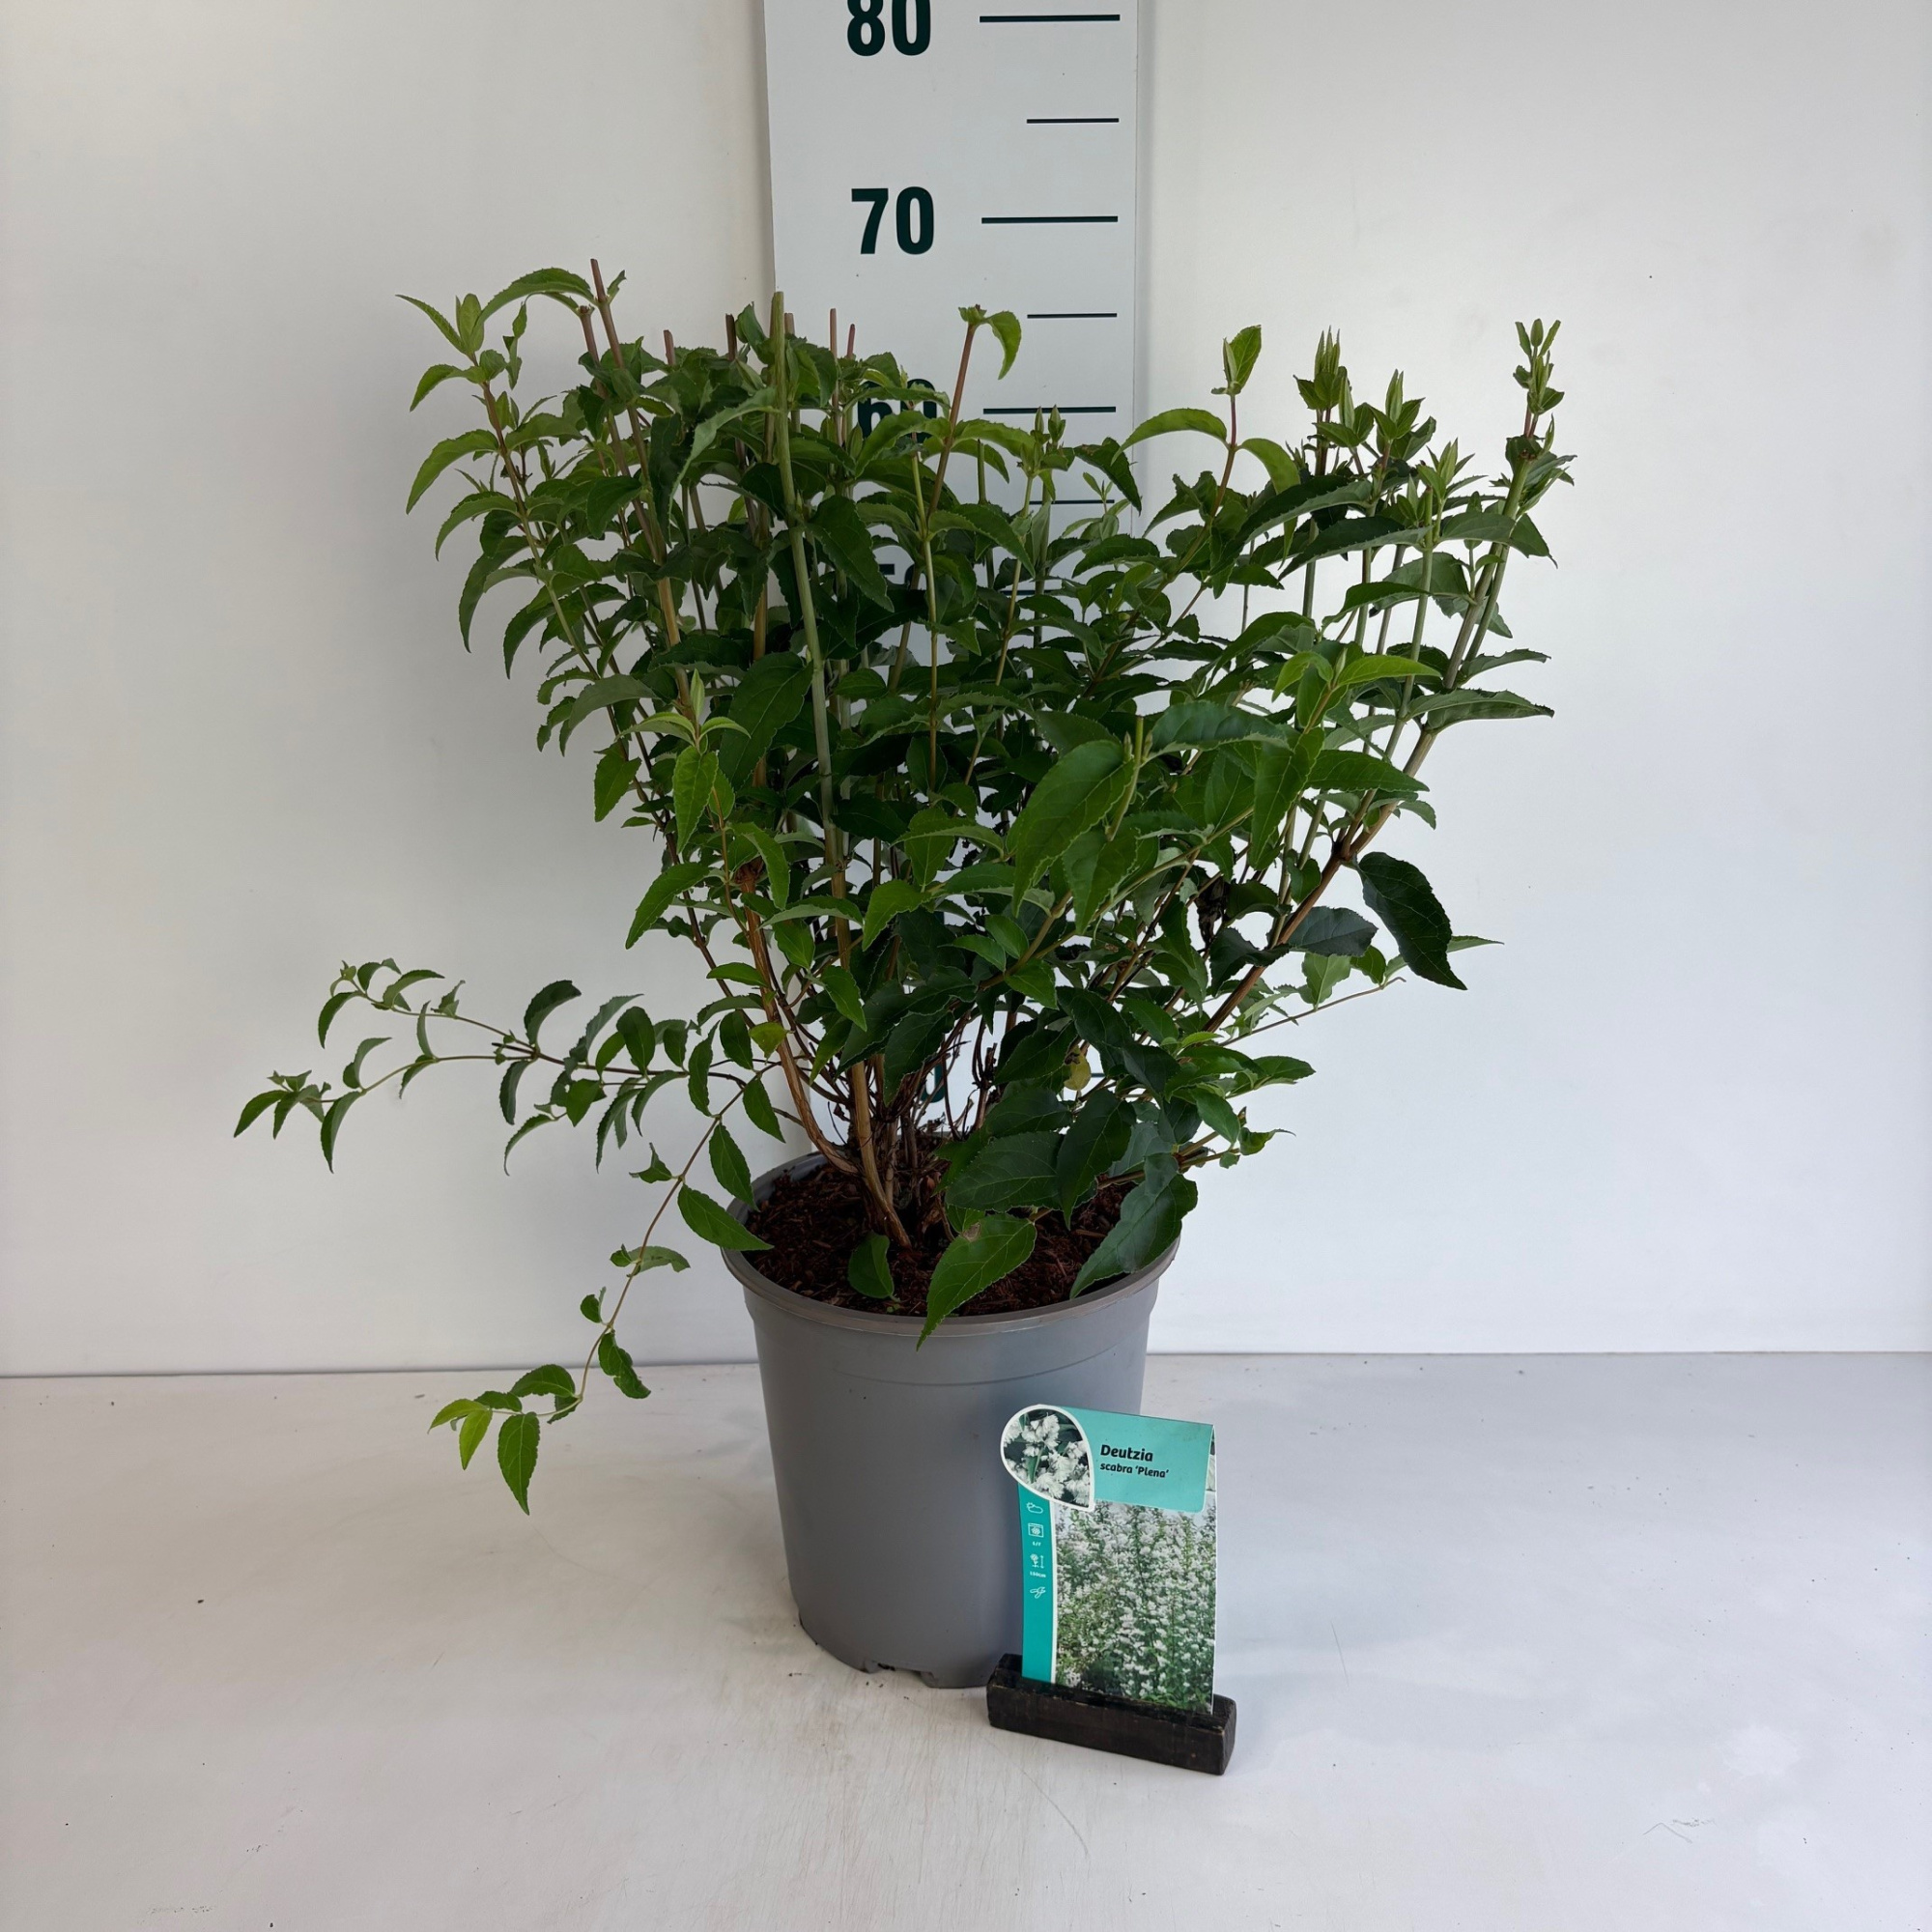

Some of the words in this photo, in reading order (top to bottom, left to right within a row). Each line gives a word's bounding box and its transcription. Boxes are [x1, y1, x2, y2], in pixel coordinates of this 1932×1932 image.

[847, 0, 931, 56] 80
[851, 186, 934, 255] 70
[1099, 1463, 1133, 1474] scabra
[1100, 1443, 1153, 1462] Deutzia
